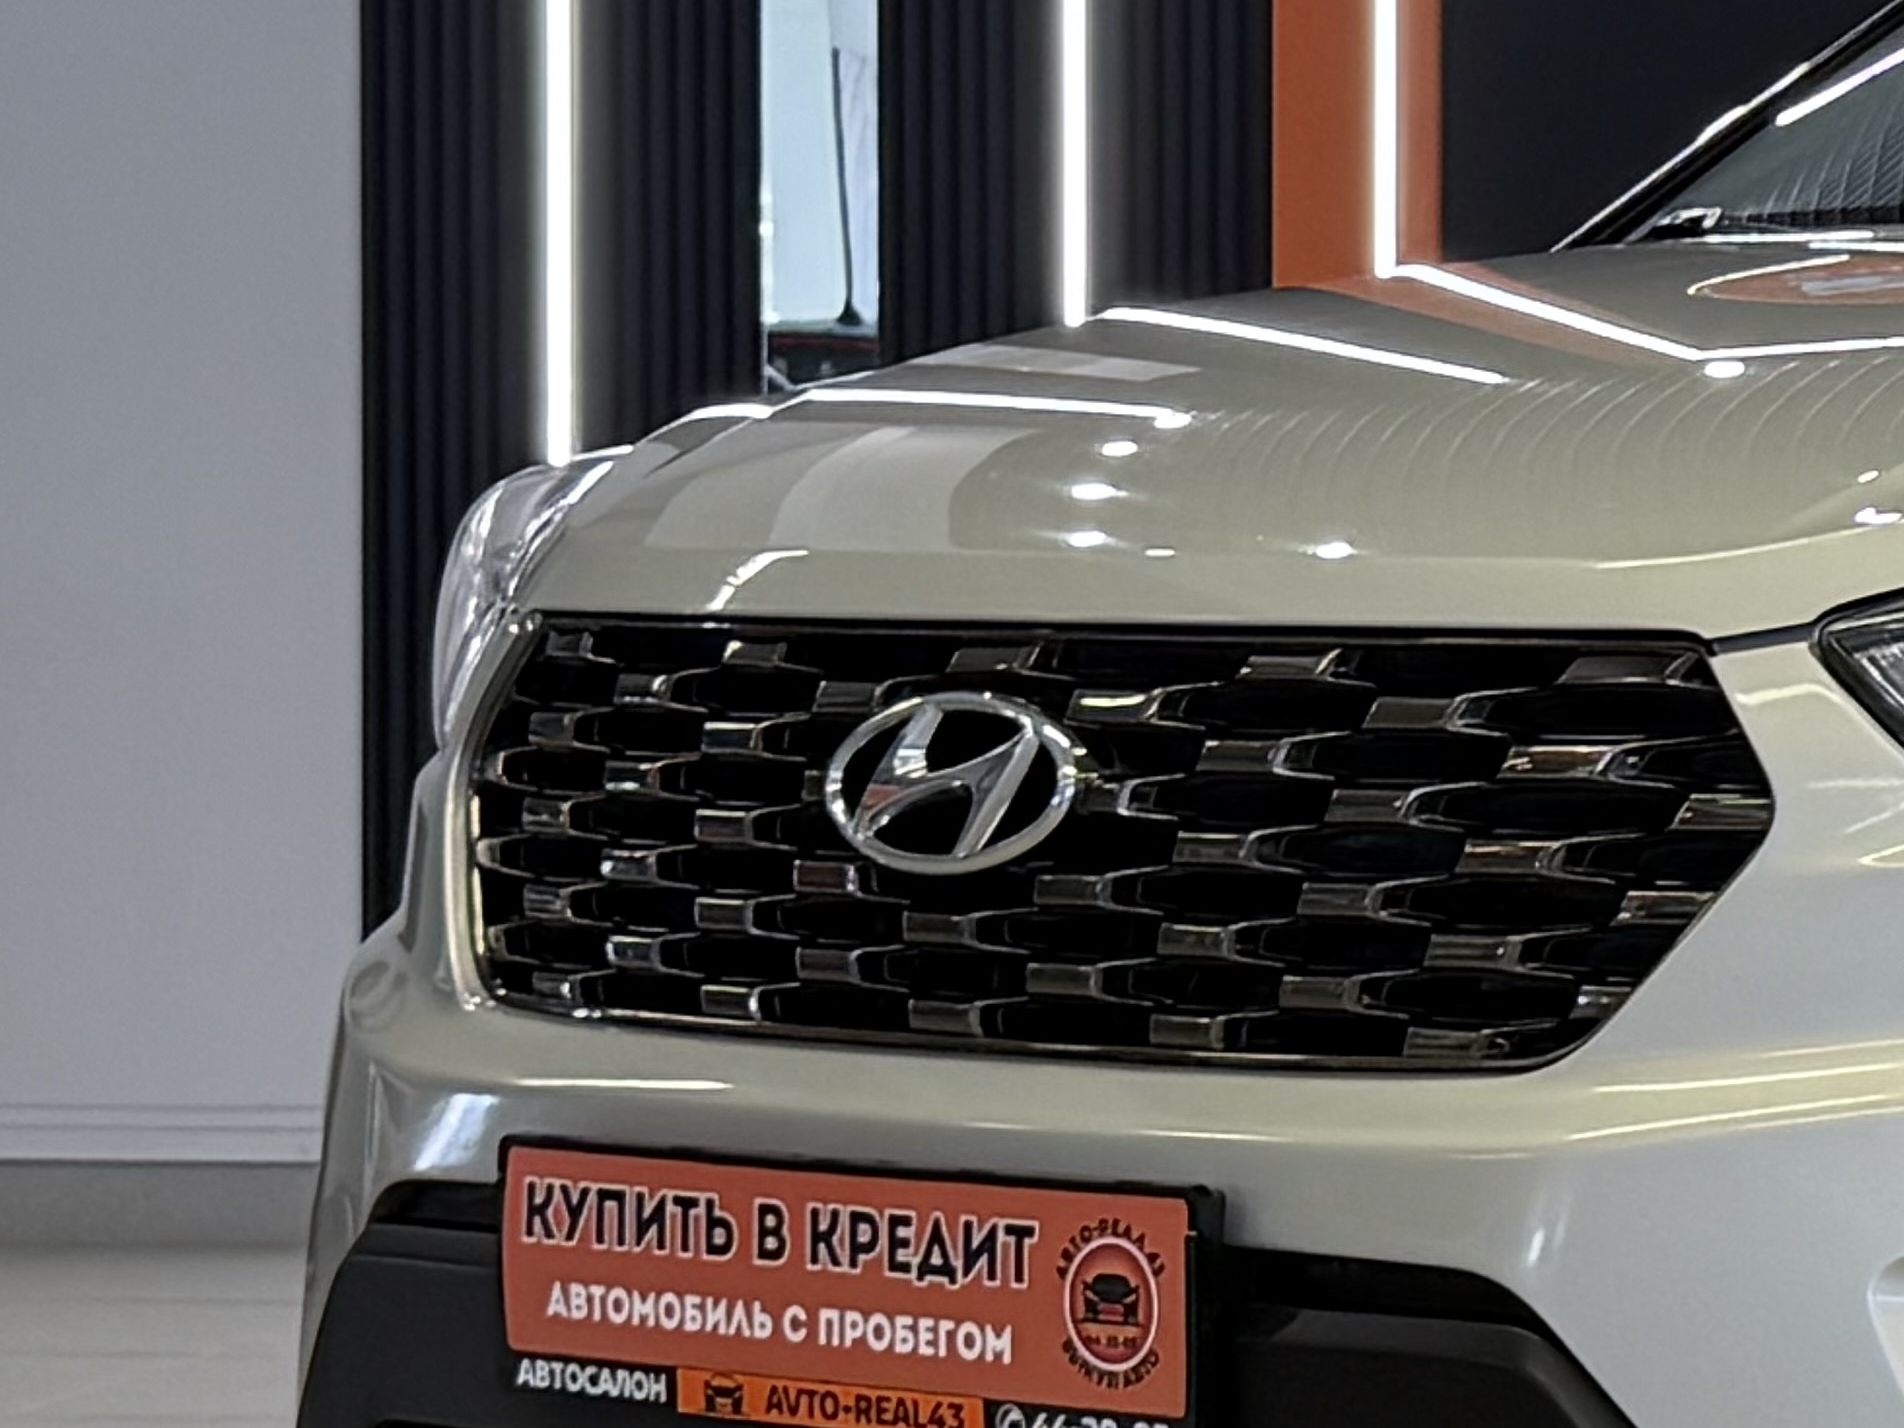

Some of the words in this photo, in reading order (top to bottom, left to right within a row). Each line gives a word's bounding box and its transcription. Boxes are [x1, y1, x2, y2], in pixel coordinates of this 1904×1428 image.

[521, 1176, 739, 1261] КУПИТЬ
[753, 1197, 790, 1265] В
[805, 1202, 1040, 1289] КРЕДИТ
[547, 1280, 774, 1339] АВТОМОБИЛЬ
[783, 1304, 808, 1343] С
[818, 1308, 1012, 1364] ПРОБЕГОМ
[516, 1358, 667, 1403] АВТОСАЛОН
